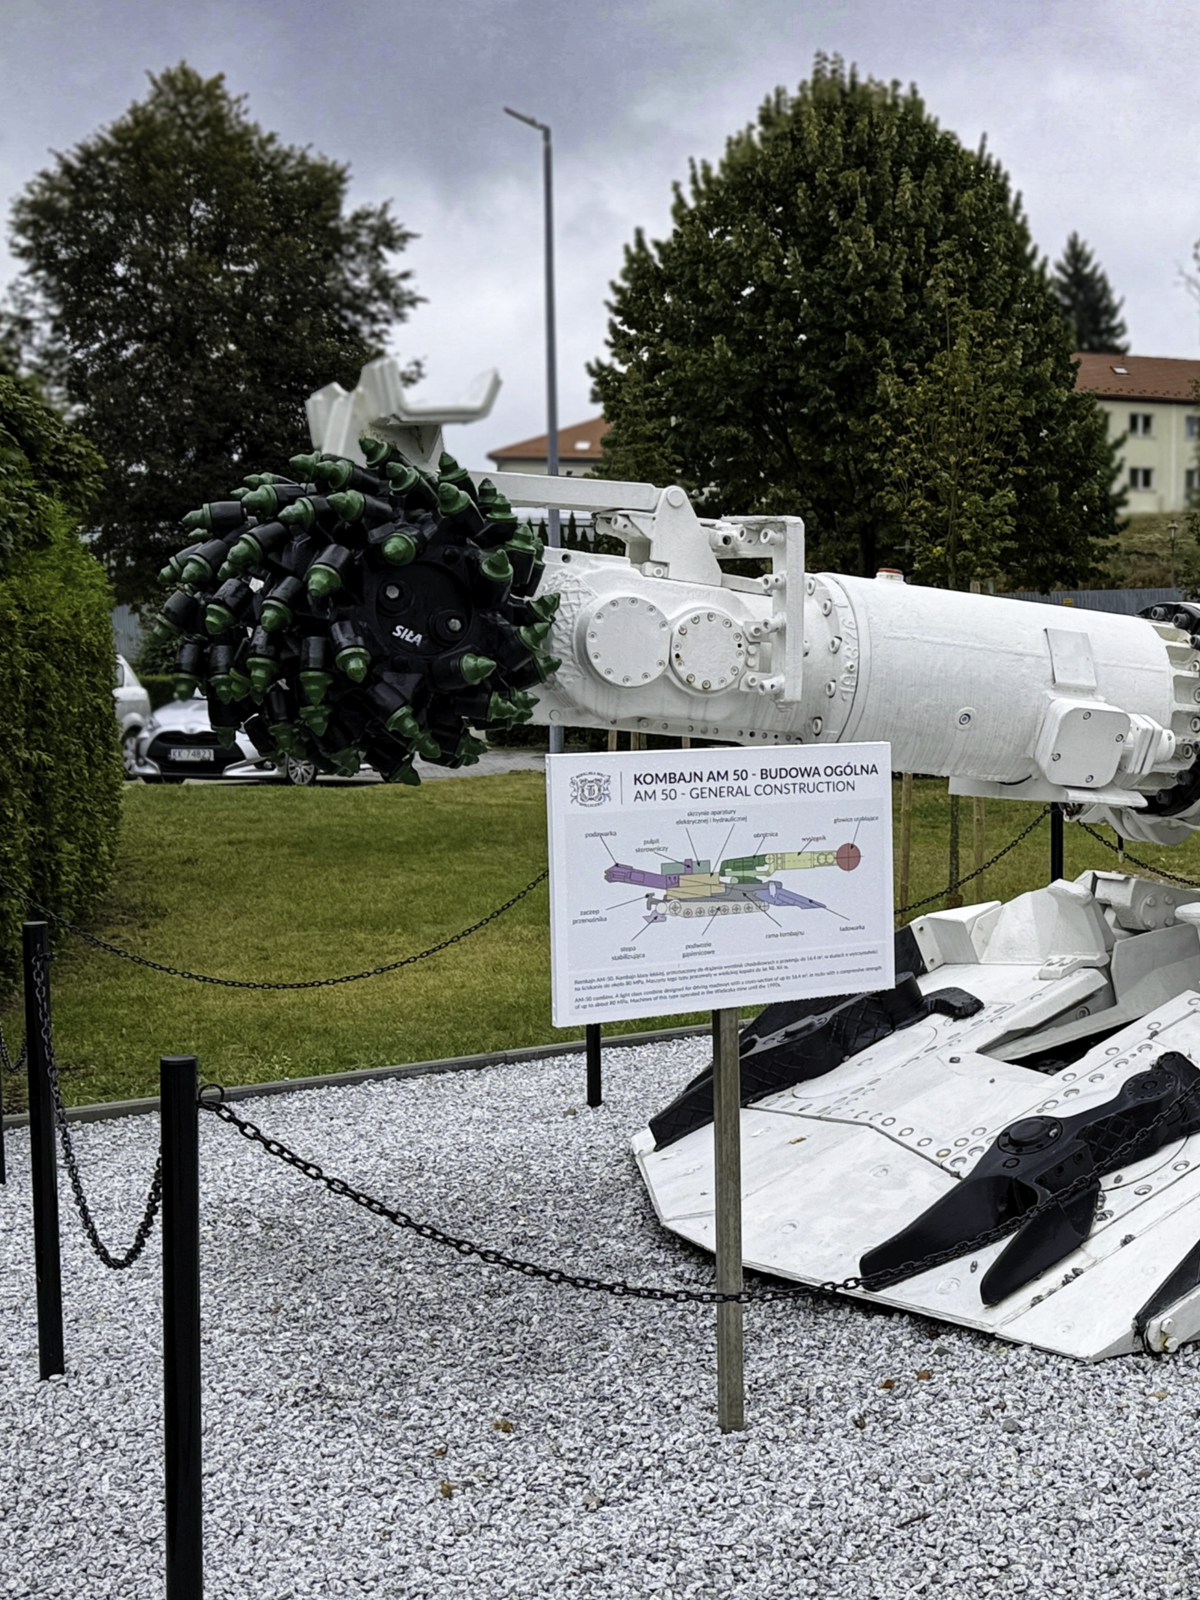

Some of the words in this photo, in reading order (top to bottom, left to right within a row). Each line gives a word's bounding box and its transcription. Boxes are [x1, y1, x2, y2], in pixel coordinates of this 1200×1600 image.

[392, 624, 422, 646] SIŁA
[634, 771, 703, 786] KOMBAJN
[706, 770, 728, 782] AM
[733, 769, 748, 781] 50
[760, 766, 821, 780] BUDOWA
[824, 762, 878, 777] OGÓLNA
[634, 790, 656, 802] AM
[661, 788, 677, 800] 50
[690, 785, 751, 799] GENERAL
[754, 780, 855, 796] CONSTRUCTION
